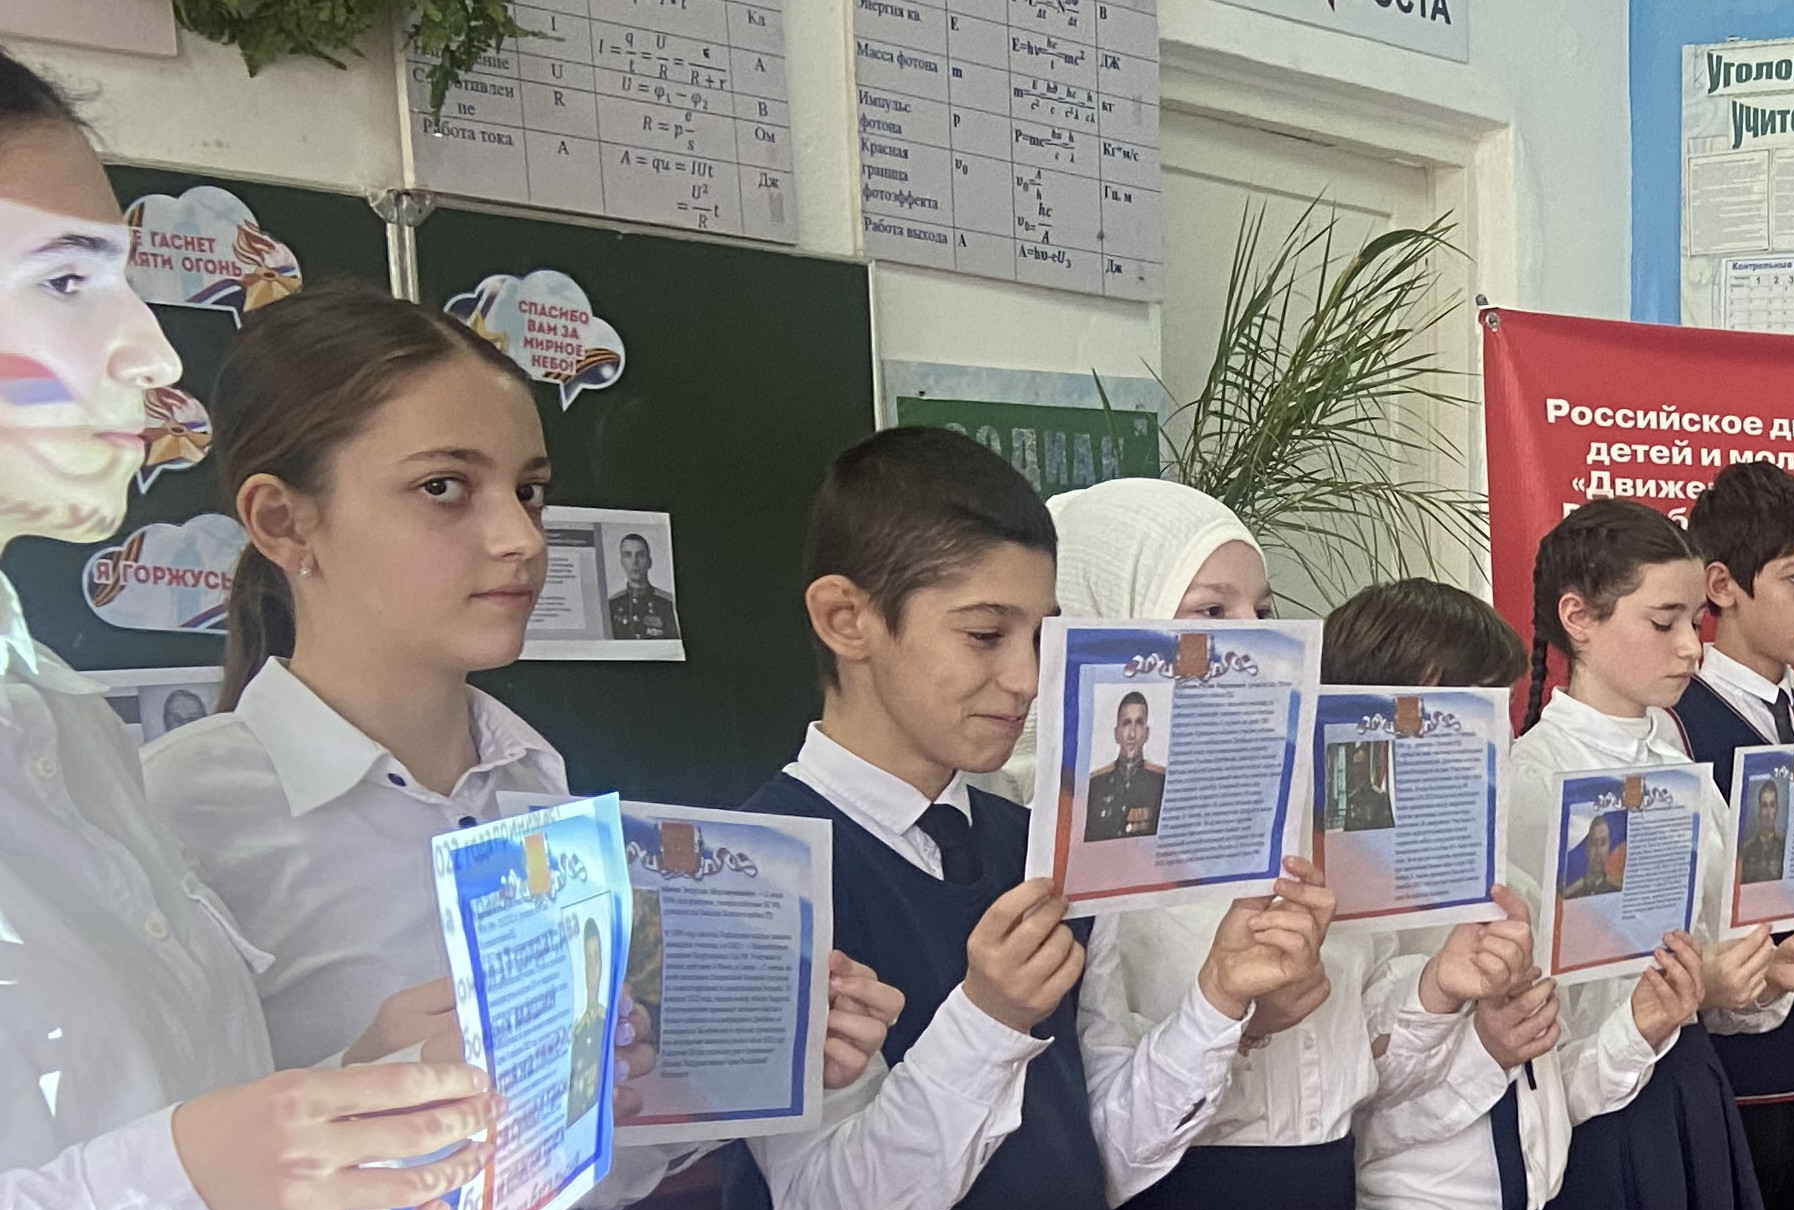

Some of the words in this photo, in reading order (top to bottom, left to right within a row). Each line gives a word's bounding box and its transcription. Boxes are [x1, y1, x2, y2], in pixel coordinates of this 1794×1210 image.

[856, 41, 894, 63] Масса
[480, 129, 514, 147] тока
[758, 172, 780, 190] Дж
[150, 231, 216, 253] ГАСНЕТ
[181, 256, 243, 277] ОГОНЬ
[1731, 260, 1793, 272] Контрольные
[518, 300, 589, 325] СПАСИБО
[527, 319, 558, 337] ВАМ
[561, 325, 580, 340] ЗА
[523, 336, 584, 358] МИРНОЕ
[531, 354, 574, 373] НЕБО!
[1546, 399, 1763, 435] Российское
[1586, 440, 1693, 467] детей
[1700, 446, 1722, 467] и
[95, 565, 110, 581] Я
[121, 564, 233, 590] ГОРЖУСЬ
